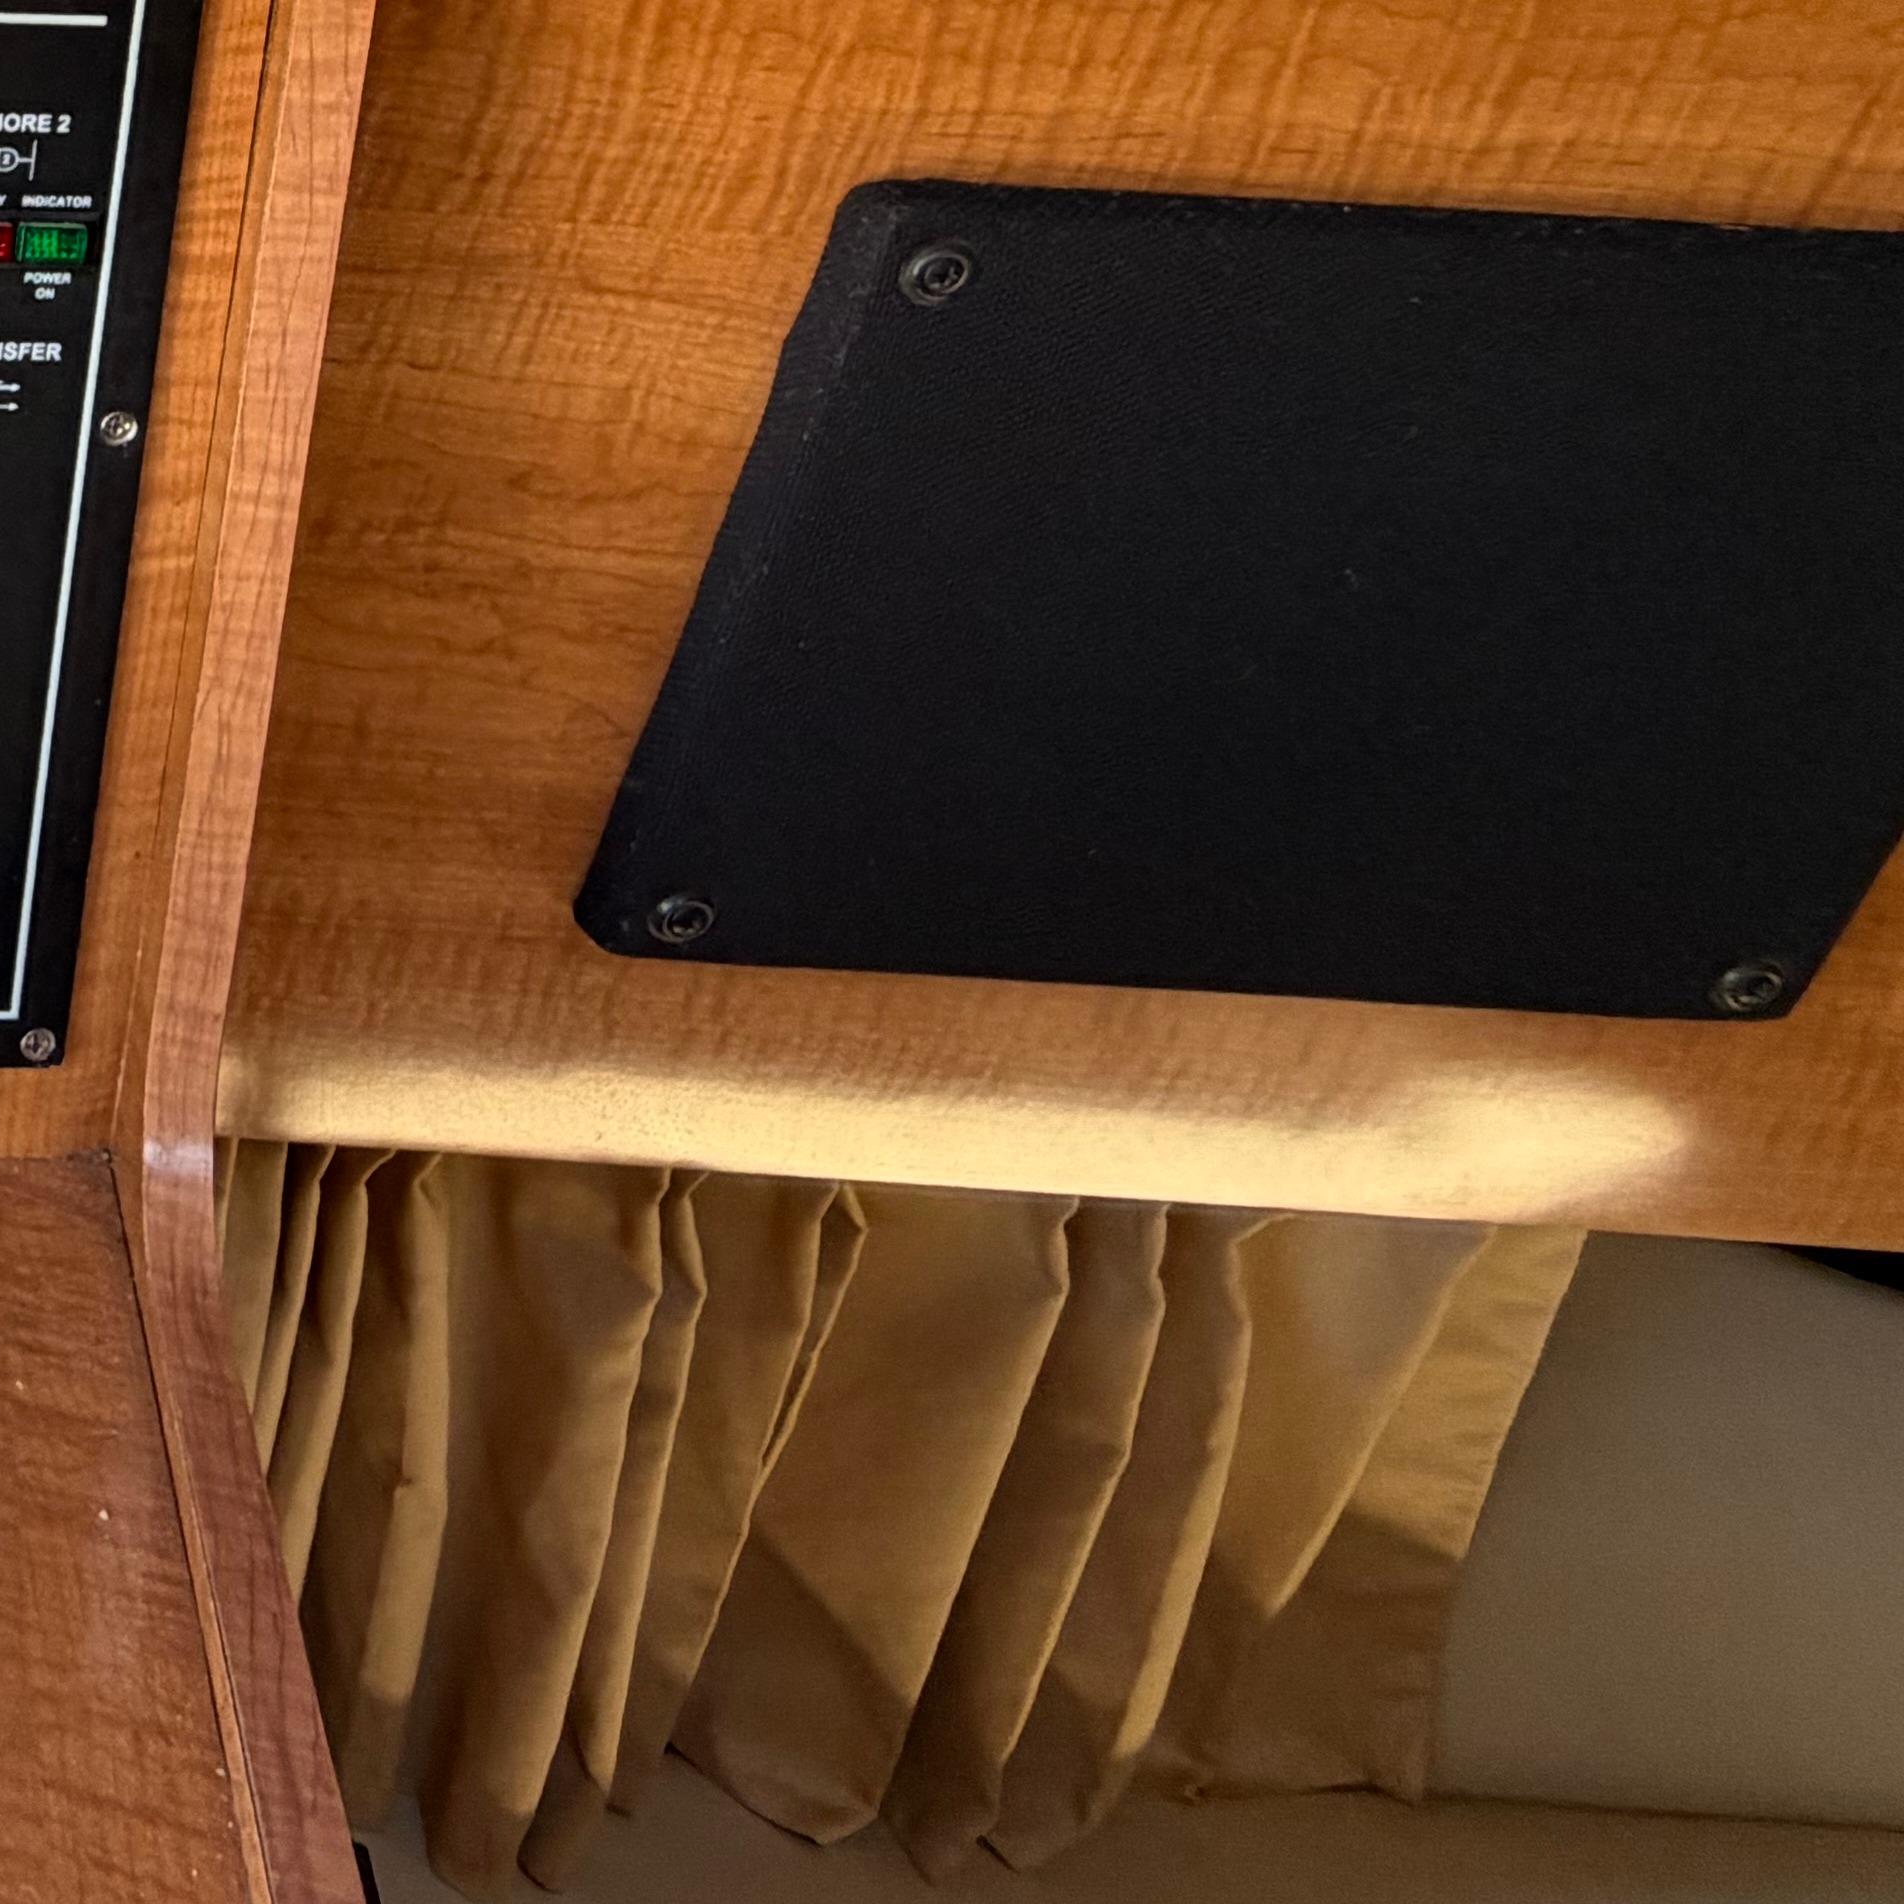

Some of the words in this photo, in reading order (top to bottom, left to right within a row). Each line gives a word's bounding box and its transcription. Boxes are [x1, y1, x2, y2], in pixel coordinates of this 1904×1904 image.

[56, 113, 72, 134] 2
[21, 194, 92, 208] INDICATOR
[23, 271, 72, 285] POWER
[34, 287, 55, 300] ON
